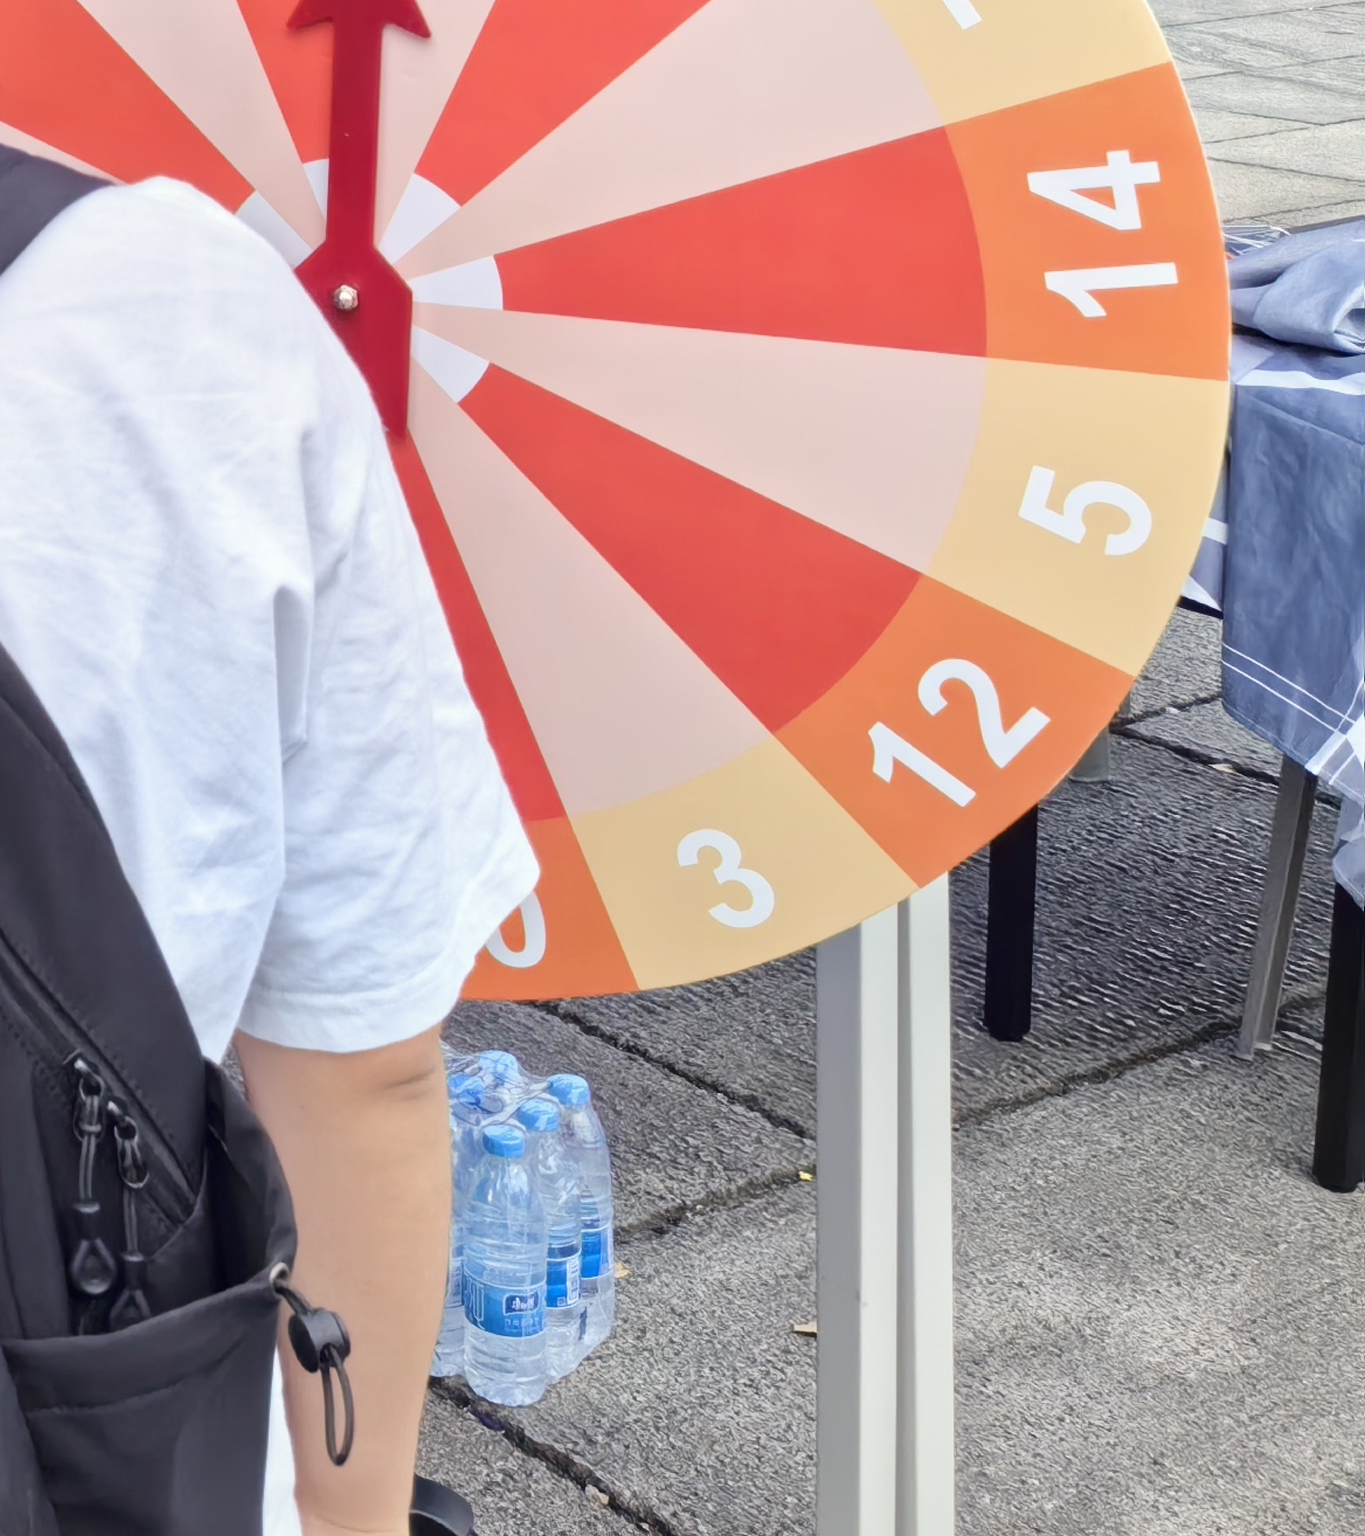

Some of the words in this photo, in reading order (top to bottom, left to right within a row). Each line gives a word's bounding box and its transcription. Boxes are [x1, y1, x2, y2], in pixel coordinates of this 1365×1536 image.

[1026, 150, 1178, 319] 14
[1018, 465, 1154, 559] 5
[869, 658, 1051, 808] 12
[677, 829, 776, 929] 3
